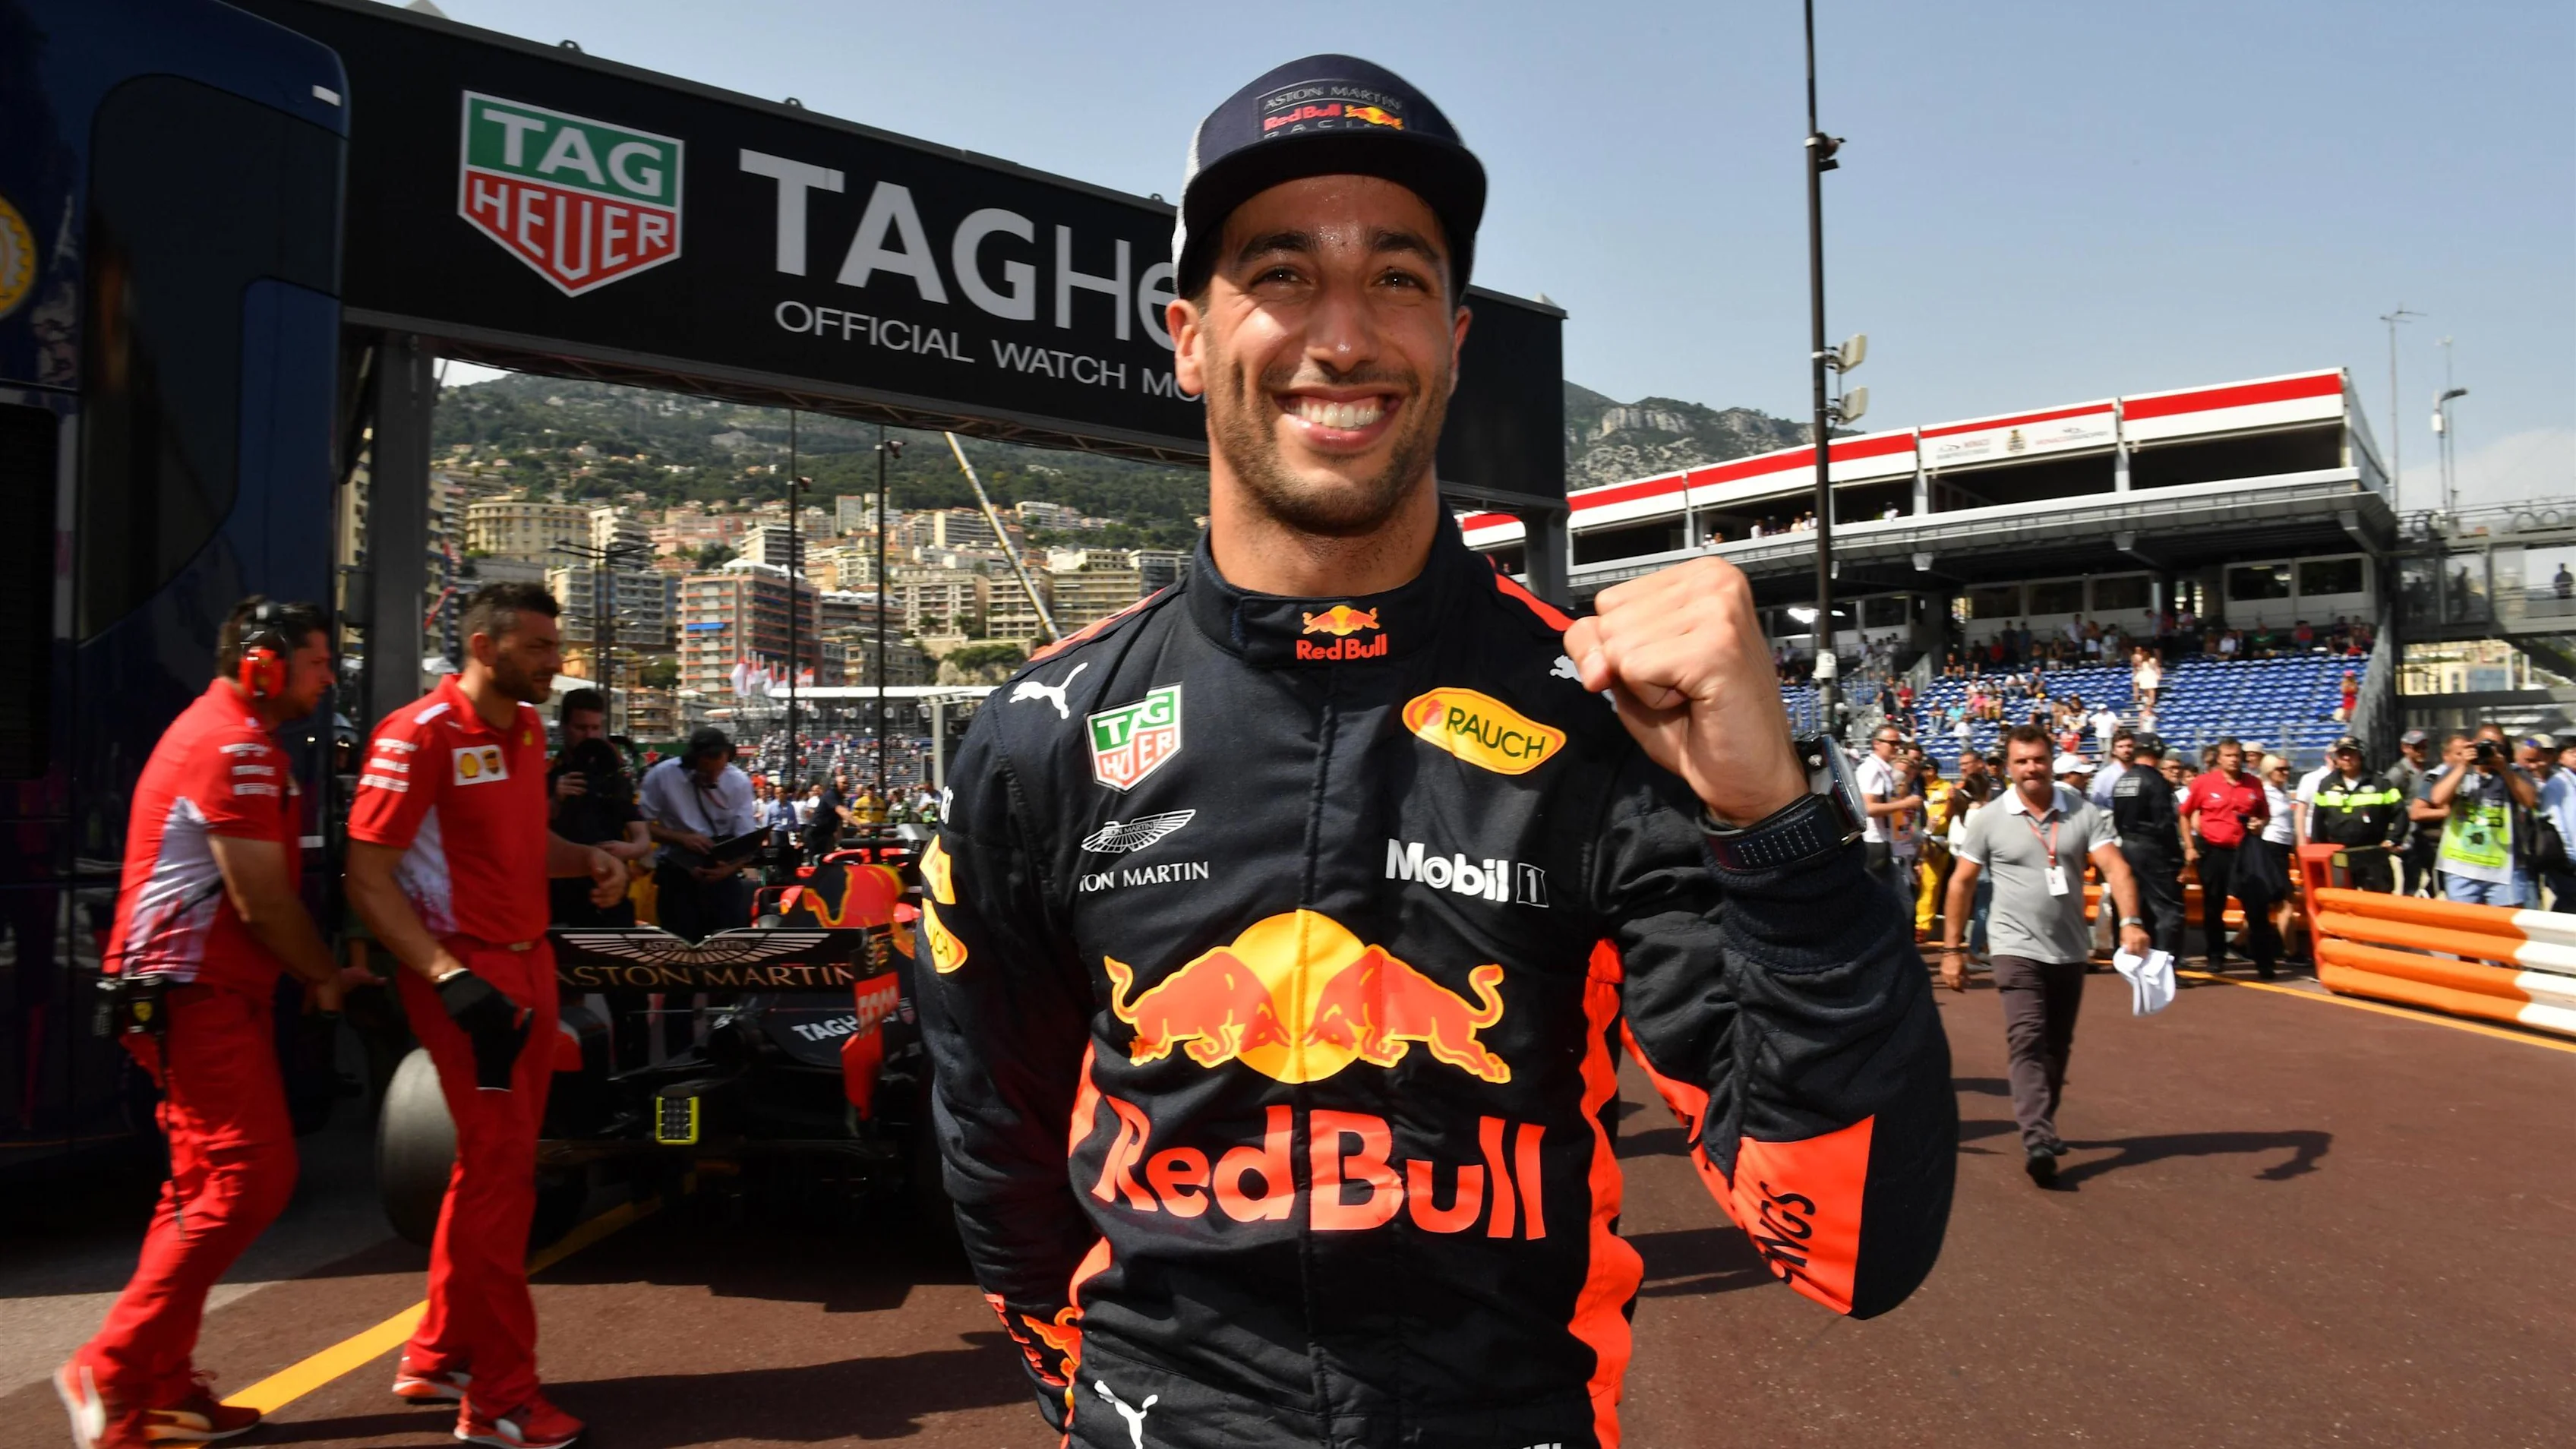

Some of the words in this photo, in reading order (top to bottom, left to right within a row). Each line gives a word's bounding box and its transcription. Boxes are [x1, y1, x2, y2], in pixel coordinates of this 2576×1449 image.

[1264, 87, 1324, 110] ASTON
[1331, 86, 1402, 110] MARTIN
[482, 108, 663, 197] TAG
[473, 179, 668, 281] HEUER
[775, 301, 975, 364] OFFICIAL
[992, 339, 1125, 390] WATCH
[1097, 696, 1170, 745] TAG
[1446, 706, 1545, 759] RAUCH
[1124, 822, 1153, 834] MARTIN
[1123, 861, 1209, 888] MARTIN
[1385, 838, 1509, 902] Mobil
[1754, 1180, 1816, 1283] NGS
